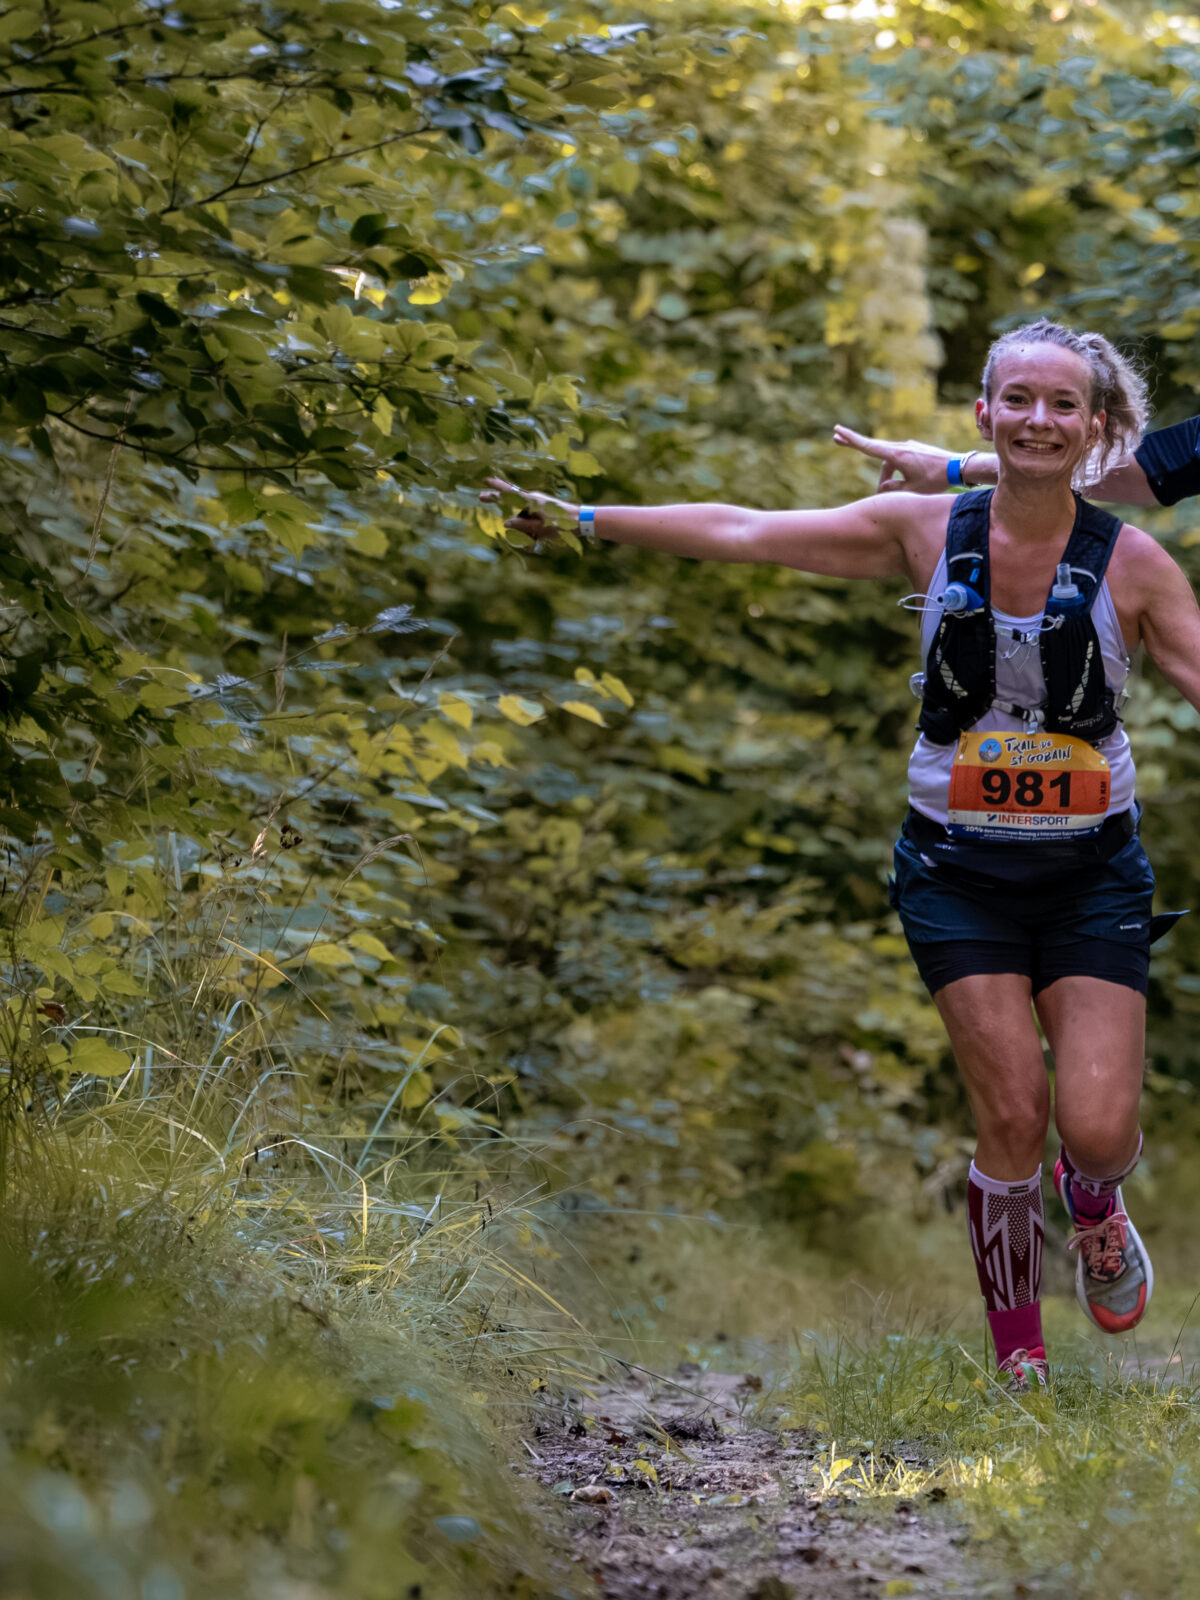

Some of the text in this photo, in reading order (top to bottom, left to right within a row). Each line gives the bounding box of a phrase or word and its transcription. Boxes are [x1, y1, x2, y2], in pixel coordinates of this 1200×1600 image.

[1004, 737, 1039, 754] TRAIL
[1026, 744, 1072, 763] GOBAIN
[982, 769, 1072, 808] 981
[998, 814, 1070, 826] INTERSPORT
